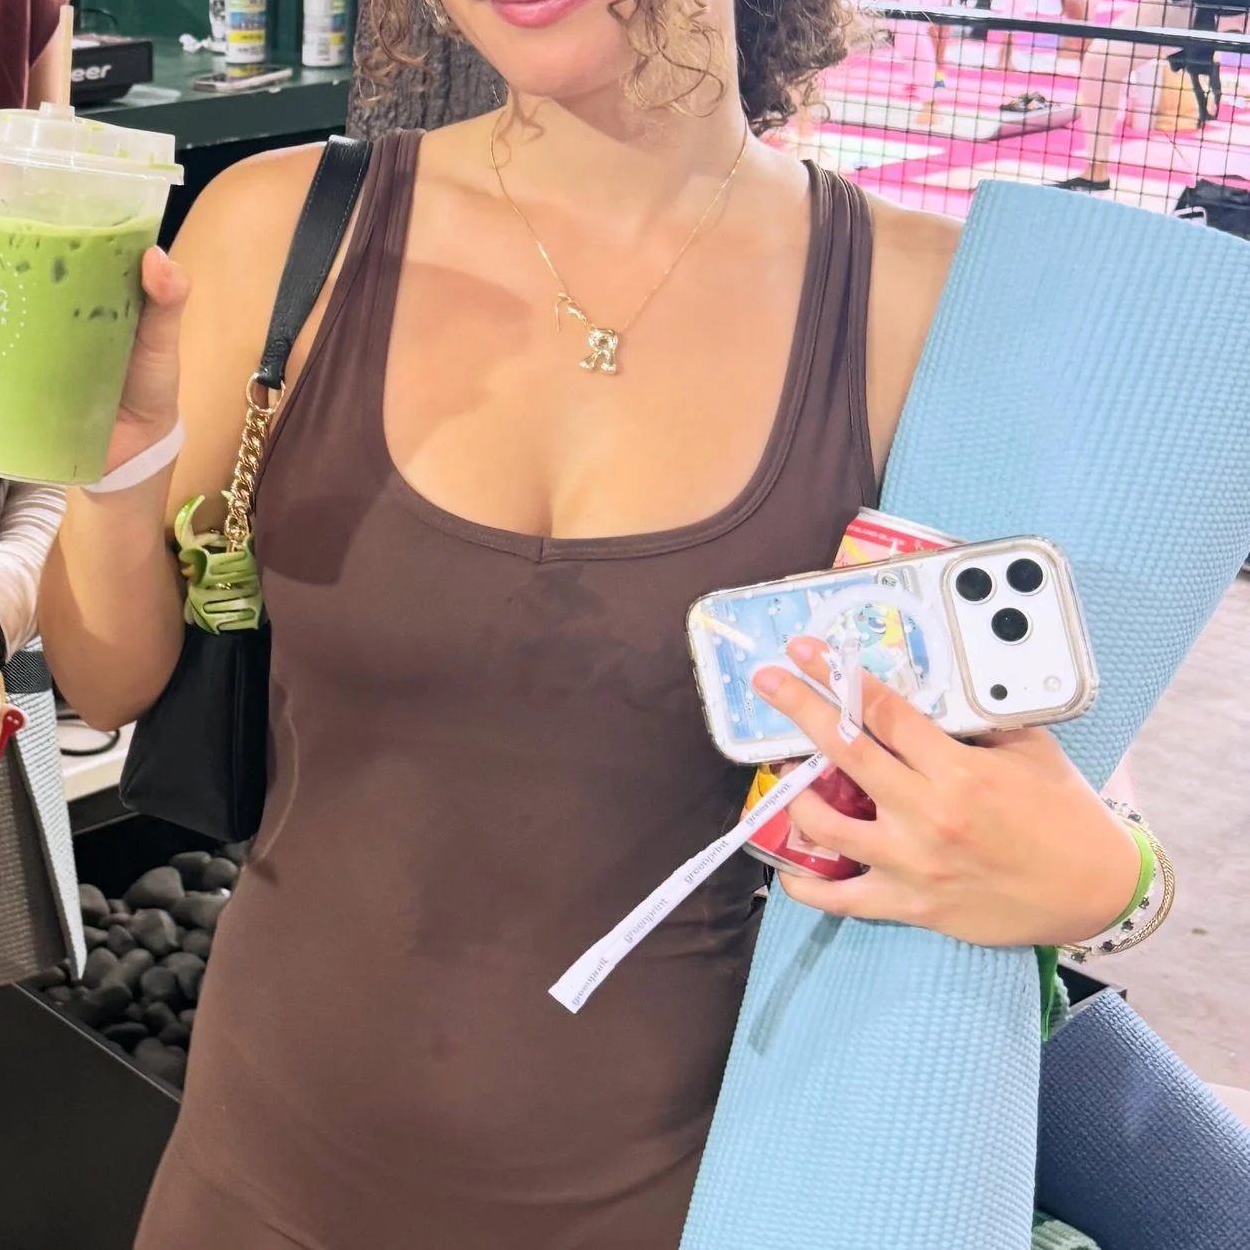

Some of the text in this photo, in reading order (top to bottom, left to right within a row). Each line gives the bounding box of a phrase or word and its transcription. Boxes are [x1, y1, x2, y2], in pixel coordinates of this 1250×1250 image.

[744, 781, 792, 827] greenprint
[683, 839, 730, 886] greenprint
[622, 897, 669, 945] greenprint
